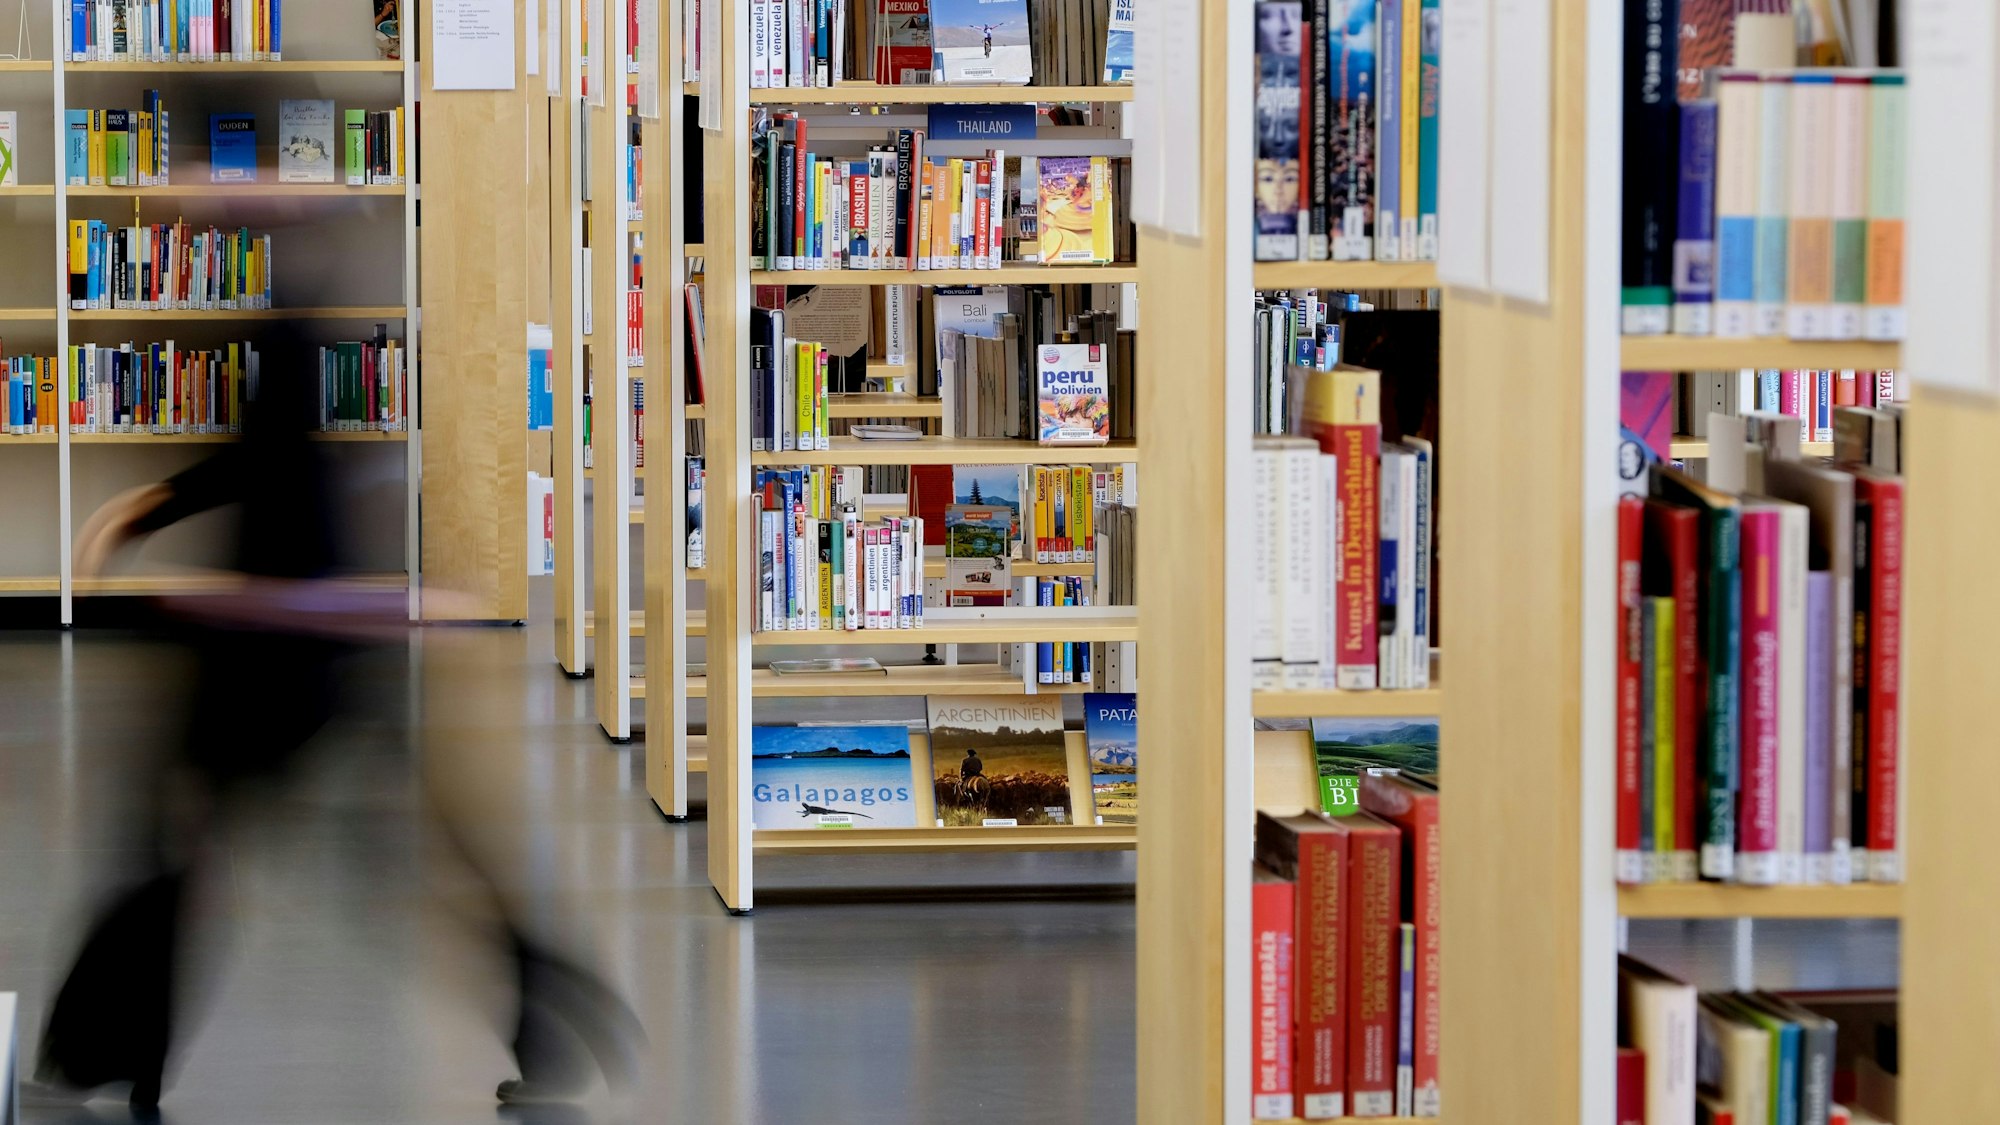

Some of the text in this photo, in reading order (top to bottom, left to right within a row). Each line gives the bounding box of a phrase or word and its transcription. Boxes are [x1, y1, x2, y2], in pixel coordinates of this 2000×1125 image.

[753, 6, 764, 57] venezuela
[771, 5, 782, 56] venezuela
[887, 2, 920, 11] MEXIKO
[1384, 33, 1394, 73] Sammlung
[1315, 84, 1326, 135] AMERIKA
[1421, 63, 1438, 118] Afrika
[219, 122, 249, 130] DUDEN
[957, 120, 1012, 134] THAILAND
[797, 148, 806, 212] Highlights BRASILIEN
[898, 134, 910, 190] BRASILIEN
[938, 170, 946, 201] BRASILIEN
[1315, 146, 1326, 204] OZEANIEN
[854, 177, 866, 226] BRASILIEN
[871, 184, 880, 238] BRASILIEN
[884, 185, 895, 239] BRASILIEN
[978, 202, 986, 256] RIO DE JANEIRO
[962, 304, 987, 317] Bali
[1042, 370, 1094, 388] peru
[1052, 385, 1102, 395] bolivien
[802, 394, 811, 417] Chile
[1038, 473, 1046, 501] Kasachstan
[1075, 479, 1083, 524] Usbekistan
[1418, 462, 1426, 504] Grönland
[1256, 458, 1265, 582] GESCHICHTE DER
[1268, 458, 1277, 594] DEUTSCHEN KUNST
[1290, 457, 1299, 581] GESCHICHTE DER
[1302, 457, 1311, 594] DEUTSCHEN KUNST
[1345, 430, 1362, 650] Kunst in Deutschland
[1364, 454, 1374, 624] Von Karl dem Großen bis Heute
[1418, 506, 1426, 523] aus
[821, 567, 829, 610] ARGENTINIEN
[868, 548, 876, 592] argentinien
[880, 547, 889, 591] argentinien
[935, 707, 1056, 723] ARGENTINIEN
[753, 784, 908, 806] Galapagos
[1328, 778, 1352, 787] DIE
[1311, 844, 1325, 1023] DUMONT GESCHICHTE
[1325, 850, 1339, 1015] DER KUNST ITALIENS
[1361, 841, 1377, 1019] DUMONT GESCHICHTE
[1376, 848, 1390, 1012] DER KUNST ITALIENS
[1426, 824, 1439, 1055] HERBSTWIND IN DEN KIEFERN
[1258, 931, 1277, 1092] DIE NEUEN HEBRÄER
[1314, 1029, 1323, 1085] WOLFGANG
[1365, 1026, 1374, 1082] WOLFGANG
